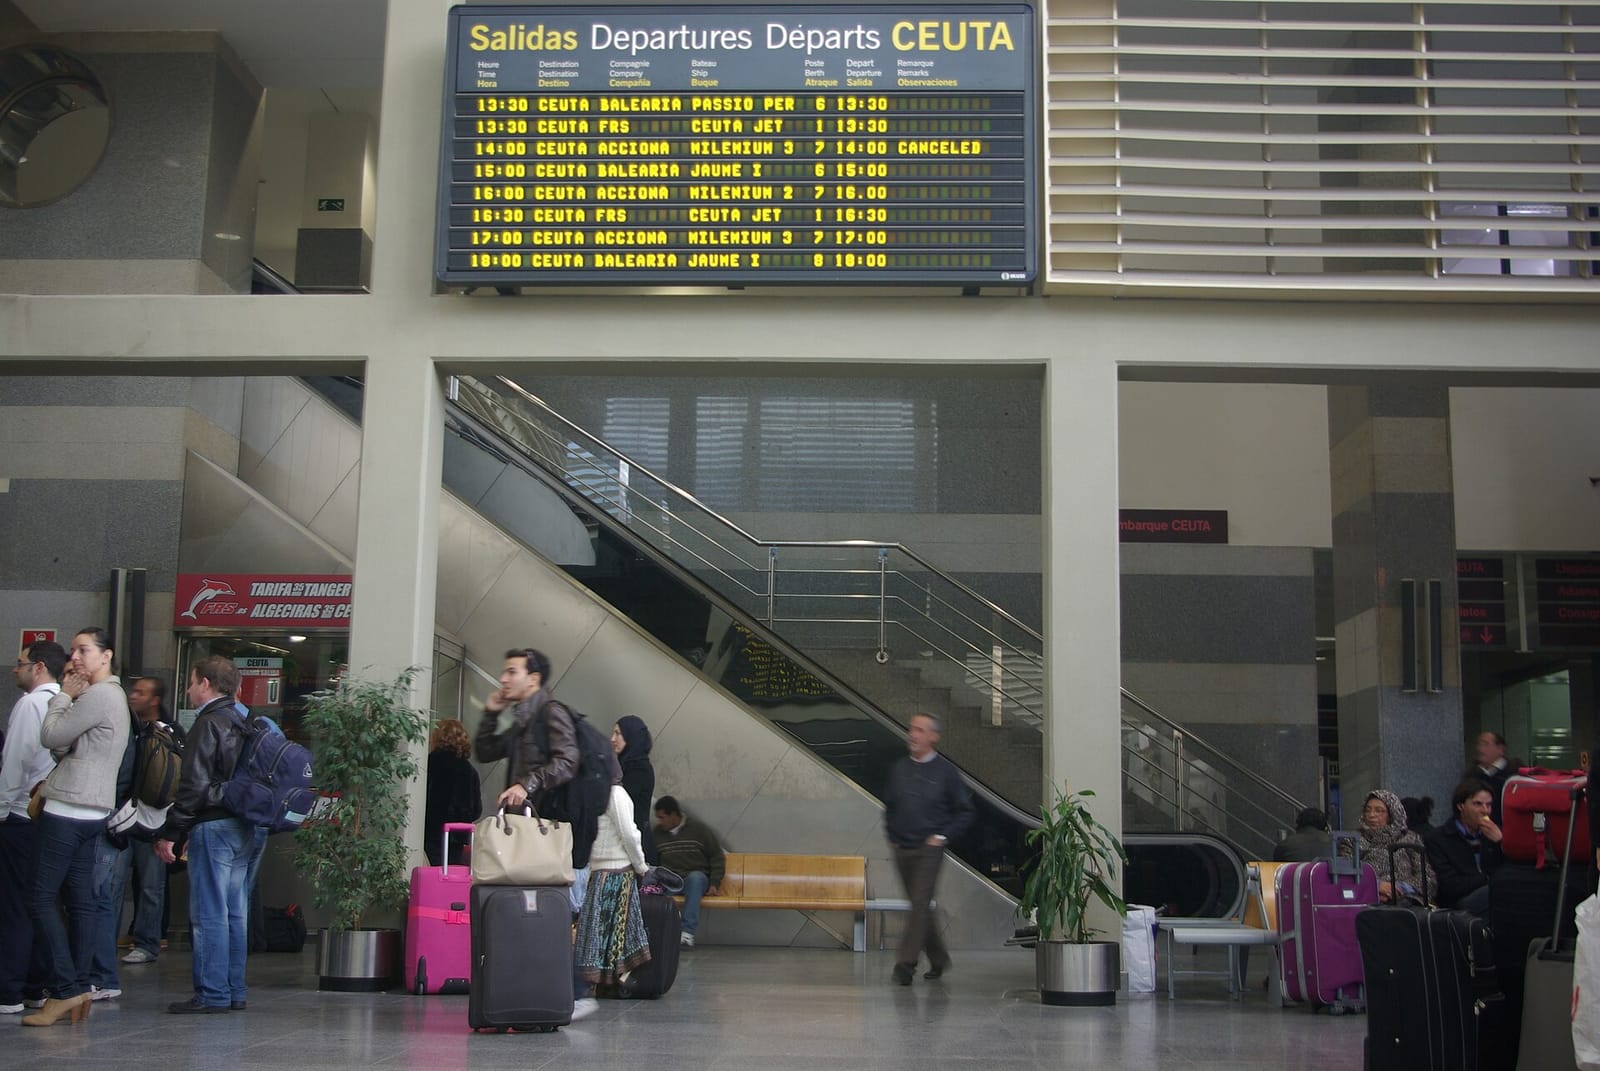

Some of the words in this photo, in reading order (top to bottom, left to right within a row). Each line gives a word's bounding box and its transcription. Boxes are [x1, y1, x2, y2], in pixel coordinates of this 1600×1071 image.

[469, 24, 578, 51] Salidas
[591, 24, 753, 55] Departures
[766, 23, 881, 54] Départs
[891, 21, 1014, 51] CEUTA
[477, 61, 500, 69] Heure
[539, 60, 579, 69] Destination
[609, 60, 650, 69] Compagnie
[691, 60, 717, 68] Bateau
[804, 59, 824, 68] Poste
[897, 59, 934, 69] Remarque
[477, 70, 497, 78] Time
[538, 69, 579, 78] Destination
[609, 69, 644, 79] Company
[691, 69, 709, 78] Ship
[804, 69, 825, 77] Berth
[846, 69, 882, 78] Departure
[897, 69, 929, 77] Remarks
[477, 79, 498, 88] Hora
[538, 79, 570, 88] Destino
[691, 78, 719, 88] Buque
[805, 78, 838, 88] Atraque
[846, 78, 873, 87] Salida
[897, 78, 958, 87] Observaciones
[478, 97, 528, 111] 13:30
[538, 97, 590, 111] CEUTA
[599, 97, 682, 111] BALEARIA
[691, 96, 754, 110] PASSIO
[763, 96, 795, 110] PER
[815, 96, 826, 110] 6
[837, 96, 888, 110] 13:30
[477, 119, 528, 133] 13:30
[537, 119, 589, 133] CEUTA
[598, 119, 630, 133] FRS
[691, 119, 743, 132] CEUTA
[753, 118, 783, 132] JET
[816, 119, 823, 132] 1
[837, 118, 888, 132] 13:30
[476, 141, 526, 155] 14:00
[536, 141, 588, 155] CEUTA
[597, 141, 670, 155] ACCIONA
[783, 140, 794, 154] 3
[814, 140, 825, 154] 7
[836, 140, 887, 154] 14:00
[897, 140, 981, 154] CANCELED
[475, 163, 526, 177] 15:00
[535, 163, 587, 177] CEUTA
[597, 162, 680, 177] BALEARIA
[690, 163, 742, 177] JAUME
[752, 163, 762, 176] I
[814, 163, 825, 176] 6
[836, 162, 888, 176] 15:00
[474, 186, 525, 199] 16:00
[534, 186, 586, 199] CEUTA
[596, 185, 669, 199] ACCIONA
[783, 185, 794, 199] 2
[814, 185, 825, 199] 7
[473, 208, 524, 222] 16:30
[533, 208, 586, 222] CEUTA
[595, 208, 627, 222] FRS
[688, 208, 741, 221] CEUTA
[751, 207, 782, 221] JET
[815, 208, 822, 221] 1
[836, 208, 887, 221] 16:30
[472, 231, 523, 244] 17:00
[532, 231, 585, 244] CEUTA
[594, 230, 668, 244] ACCIONA
[782, 230, 793, 244] 3
[813, 230, 824, 244] 7
[835, 230, 887, 244] 17:00
[471, 253, 522, 267] 18:00
[531, 253, 584, 267] CEUTA
[594, 253, 678, 267] BALEARIA
[687, 253, 740, 267] JAUME
[750, 253, 760, 267] I
[835, 253, 887, 267] 18:00
[1171, 520, 1212, 531] CEUTA
[250, 582, 293, 596] TARIFA
[304, 583, 352, 597] TANGER
[250, 603, 321, 618] ALGECIRAS
[247, 658, 269, 667] CEUTA
